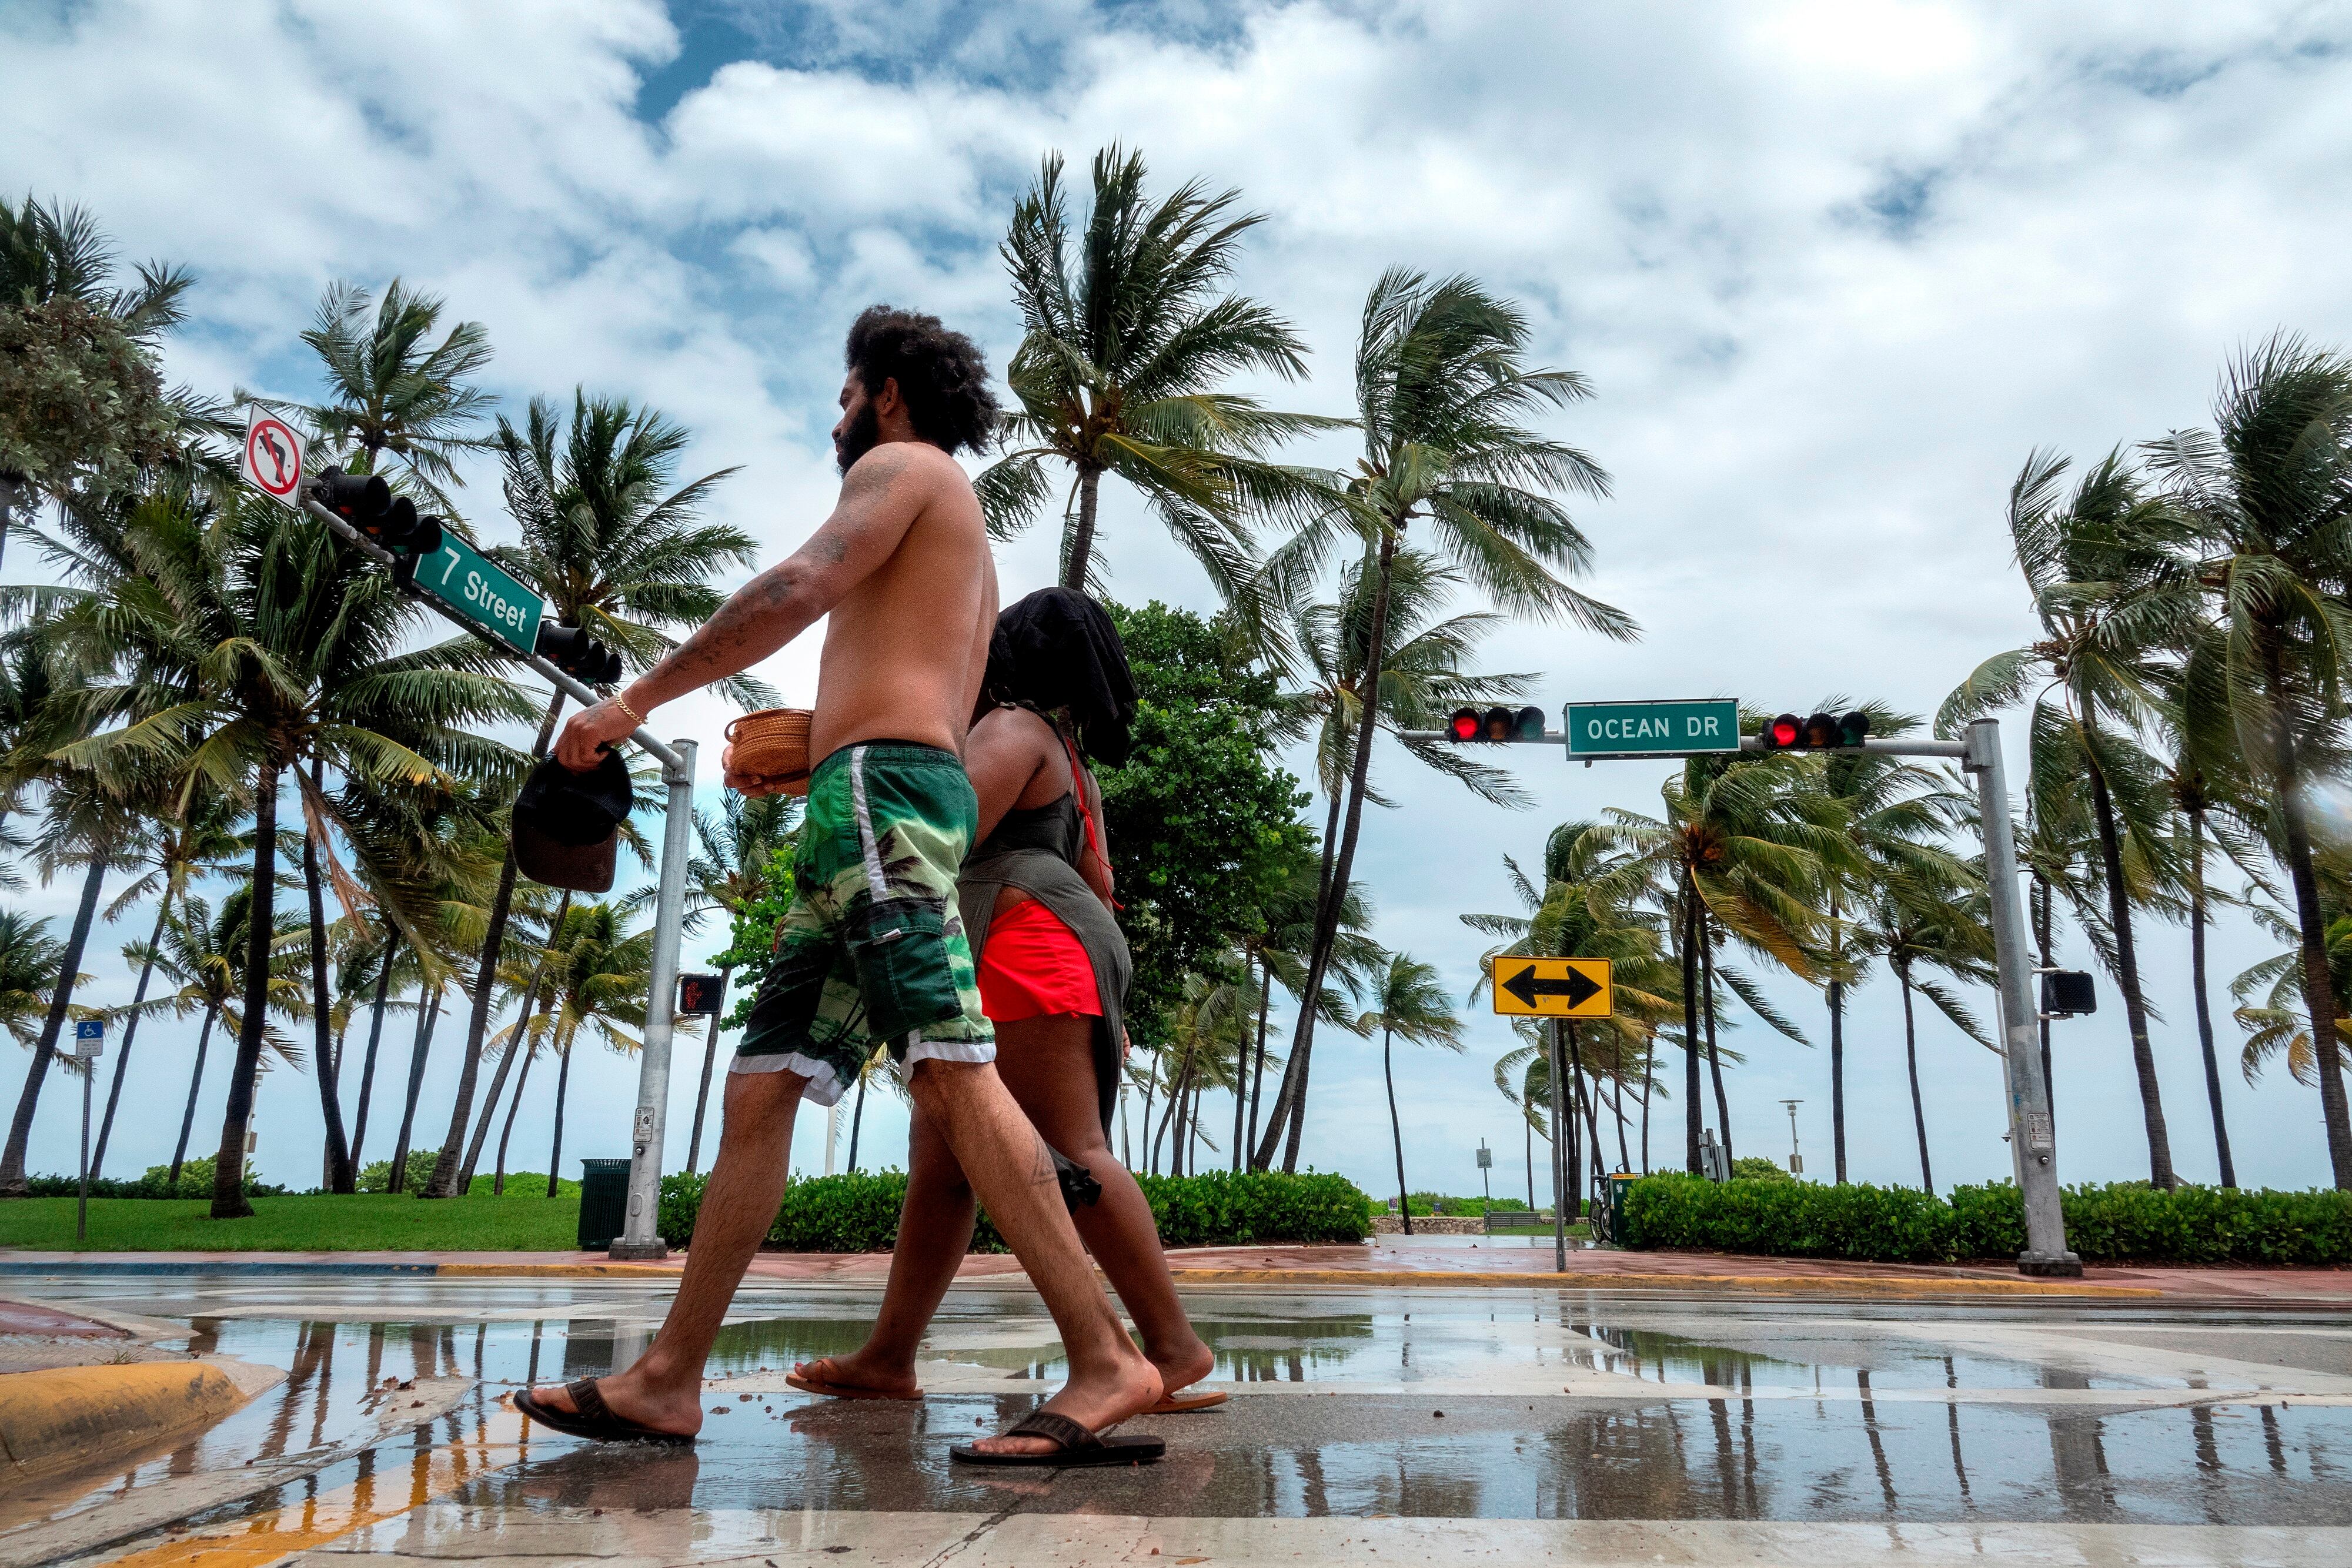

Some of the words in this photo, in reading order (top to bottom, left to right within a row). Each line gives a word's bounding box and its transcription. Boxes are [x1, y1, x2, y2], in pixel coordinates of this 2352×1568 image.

[441, 546, 461, 586] 7
[464, 570, 527, 633] Street
[1588, 717, 1670, 740] OCEAN
[1686, 716, 1720, 737] DR
